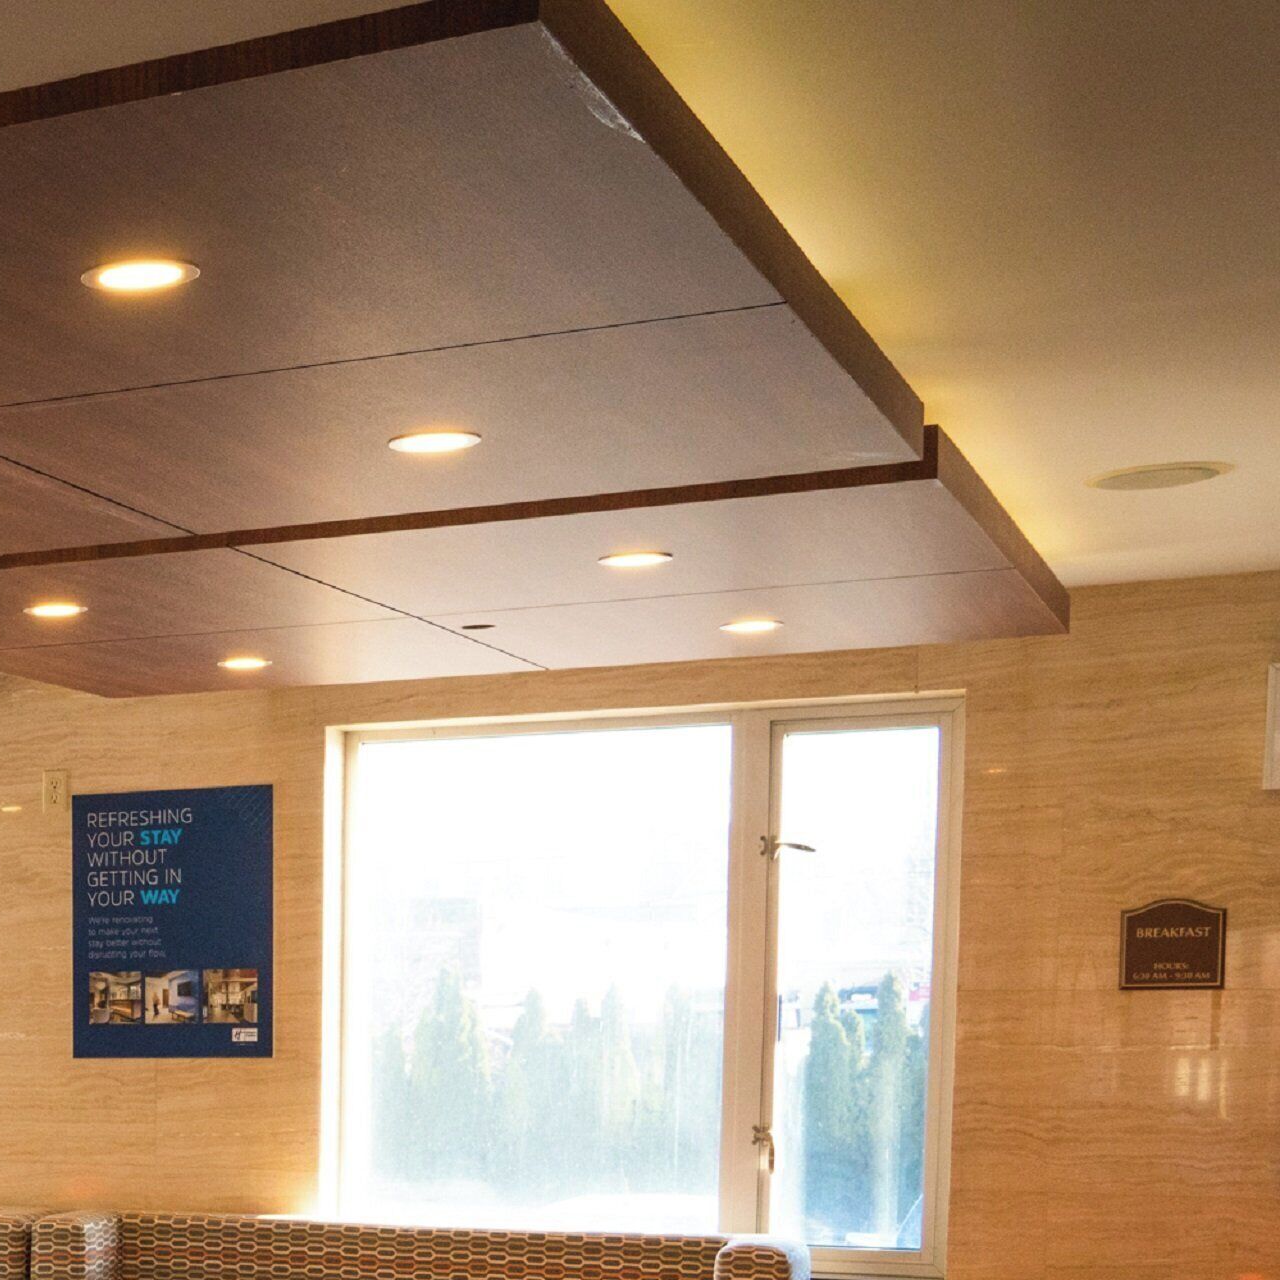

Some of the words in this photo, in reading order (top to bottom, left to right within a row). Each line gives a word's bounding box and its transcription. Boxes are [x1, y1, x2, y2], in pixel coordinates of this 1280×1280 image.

[87, 807, 193, 828] REFRESHING
[87, 831, 134, 848] YOUR
[140, 828, 182, 845] STAY
[87, 848, 167, 867] WITHOUT
[87, 868, 159, 887] GETTING
[165, 868, 182, 884] IN
[87, 890, 135, 907] YOUR
[140, 888, 180, 905] WAY
[1136, 926, 1211, 937] BREAKFAST
